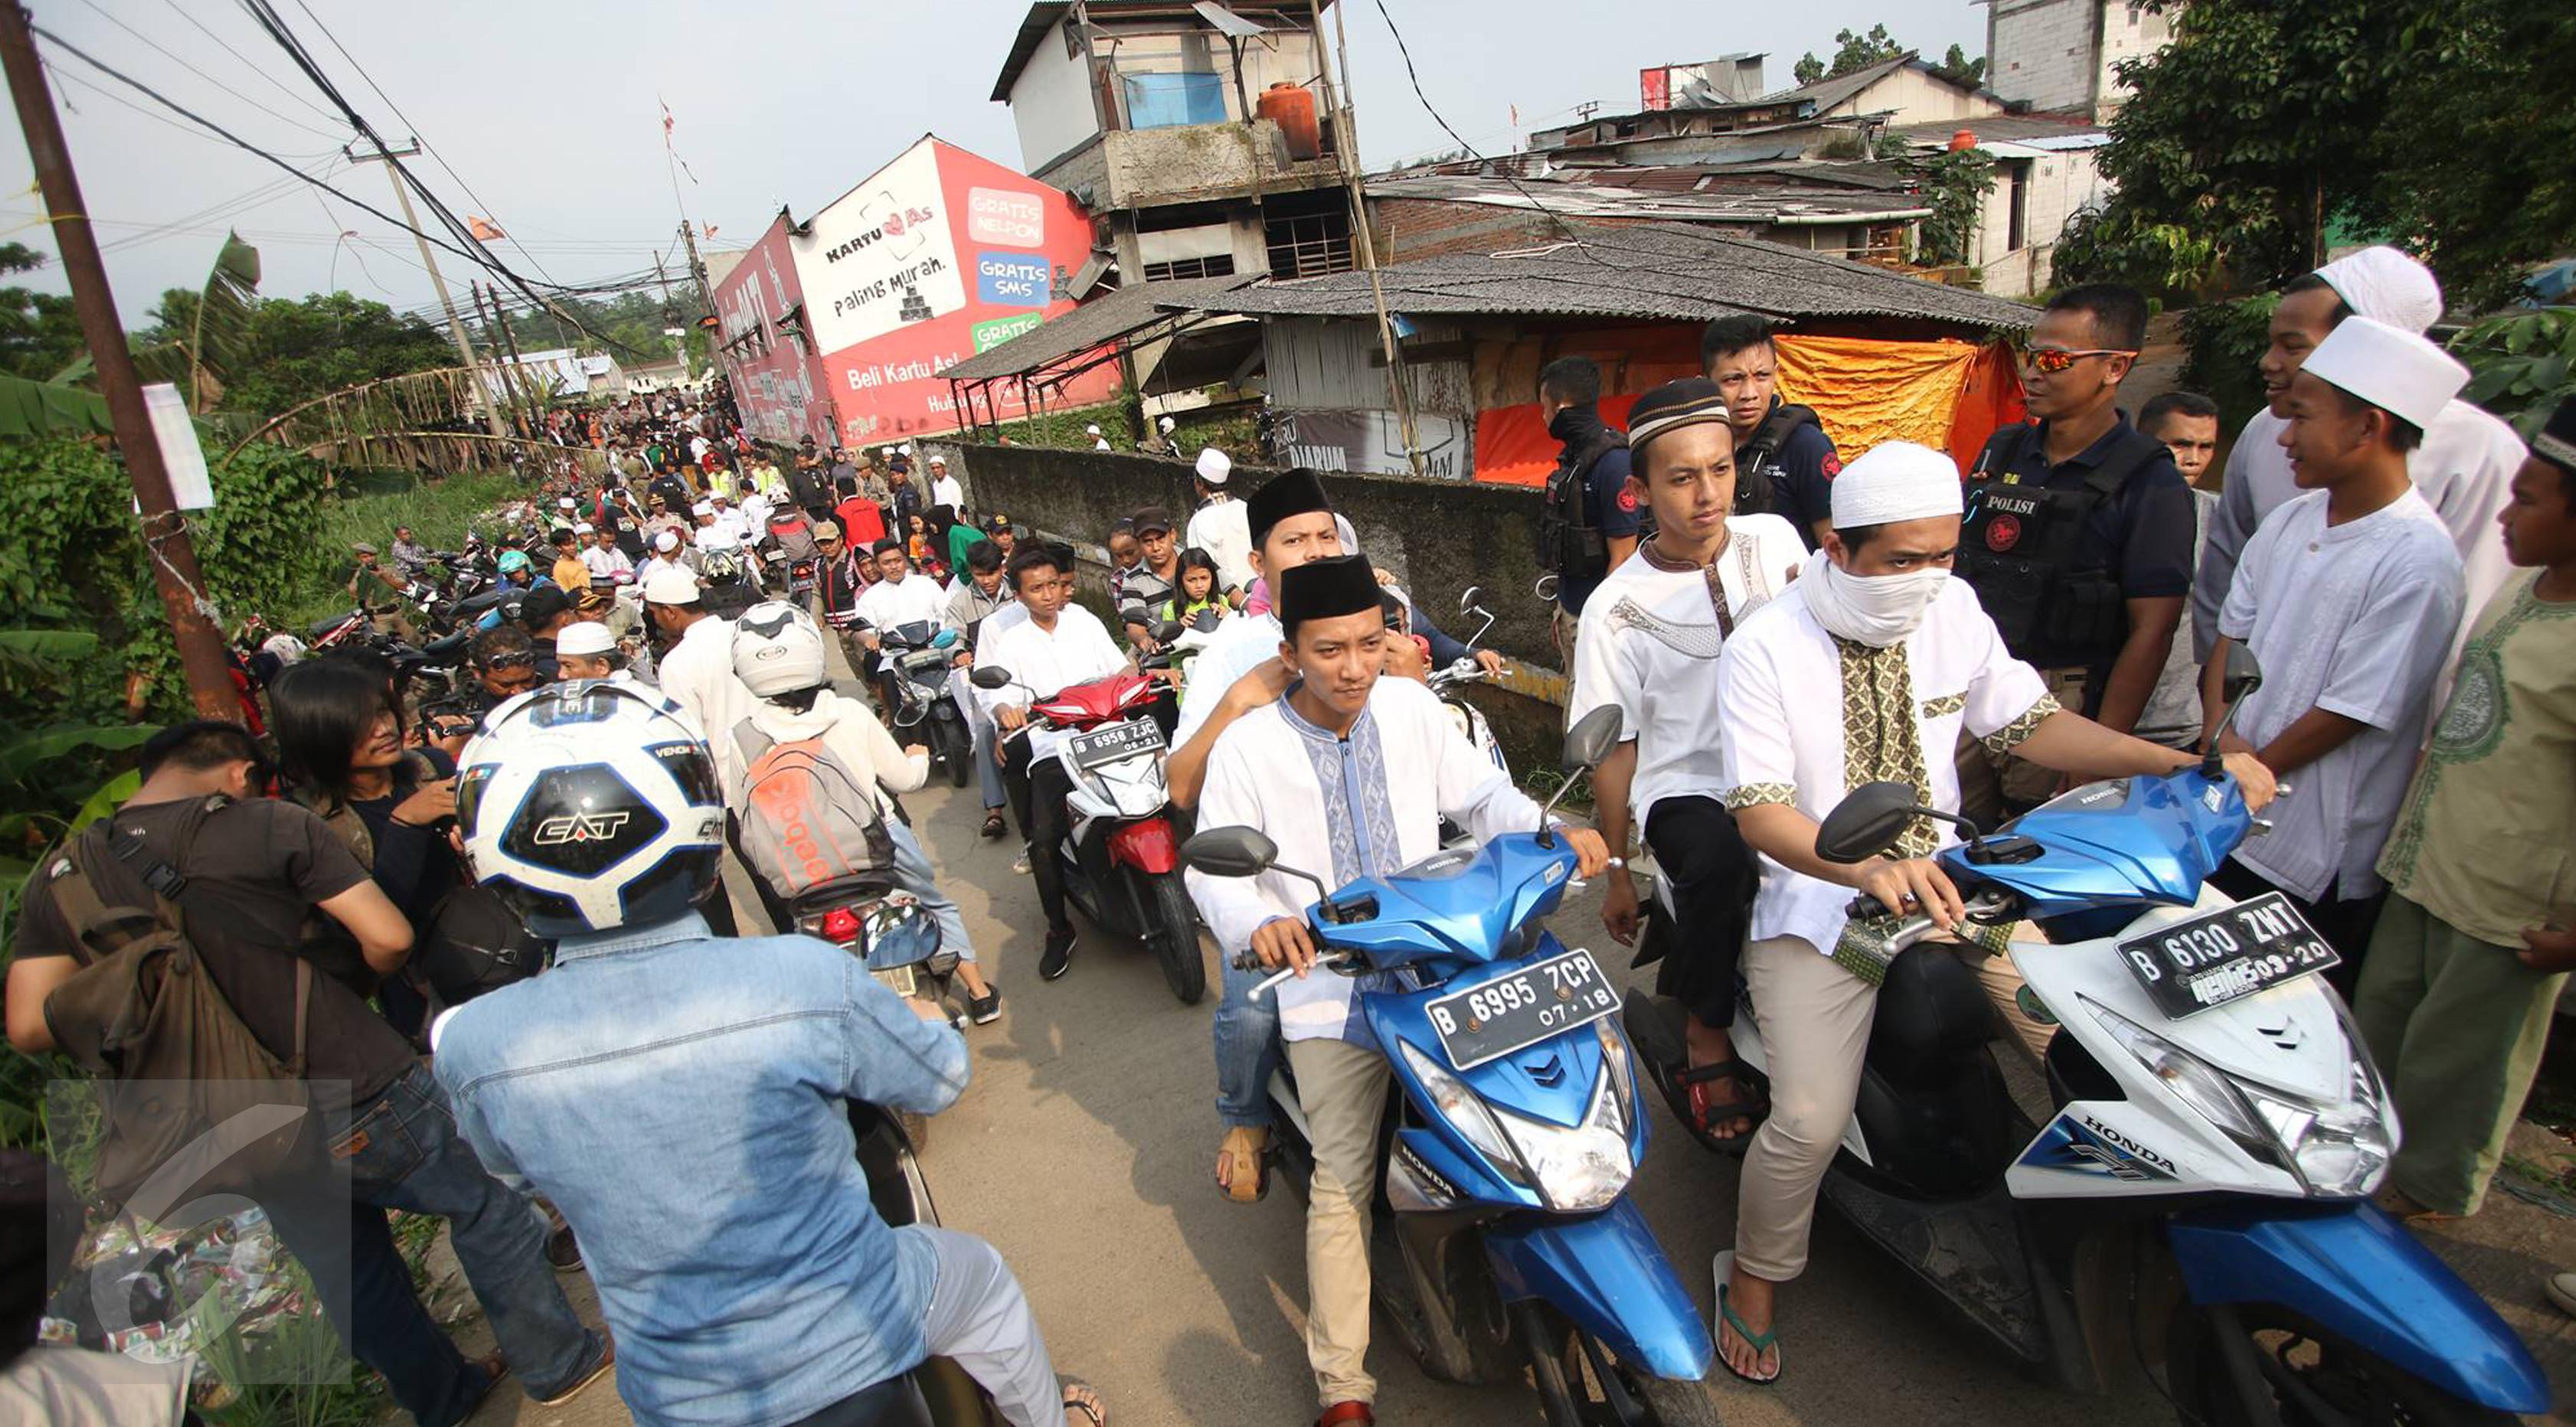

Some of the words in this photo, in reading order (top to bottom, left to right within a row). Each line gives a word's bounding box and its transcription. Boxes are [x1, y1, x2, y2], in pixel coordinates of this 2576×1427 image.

[973, 196, 1040, 221] GRATIS
[825, 227, 883, 264] KARTU
[904, 206, 933, 228] As
[976, 217, 1040, 240] NELPON
[980, 260, 1047, 282] GRATIS
[995, 280, 1033, 297] SMS
[846, 366, 882, 390] Beli
[884, 358, 931, 383] Kartu
[1986, 495, 2036, 515] POLISI
[1077, 740, 1087, 753] B
[1093, 730, 1127, 748] 6958
[1130, 723, 1156, 740] ZJC
[534, 811, 630, 844] CAT
[2128, 949, 2162, 982] B
[2165, 923, 2240, 968] 6130
[1432, 1006, 1457, 1037] B
[1468, 976, 1538, 1023] 6995
[1543, 956, 1592, 991] 7CP
[2084, 1115, 2179, 1175] HONDA
[1402, 1145, 1456, 1199] HONDA
